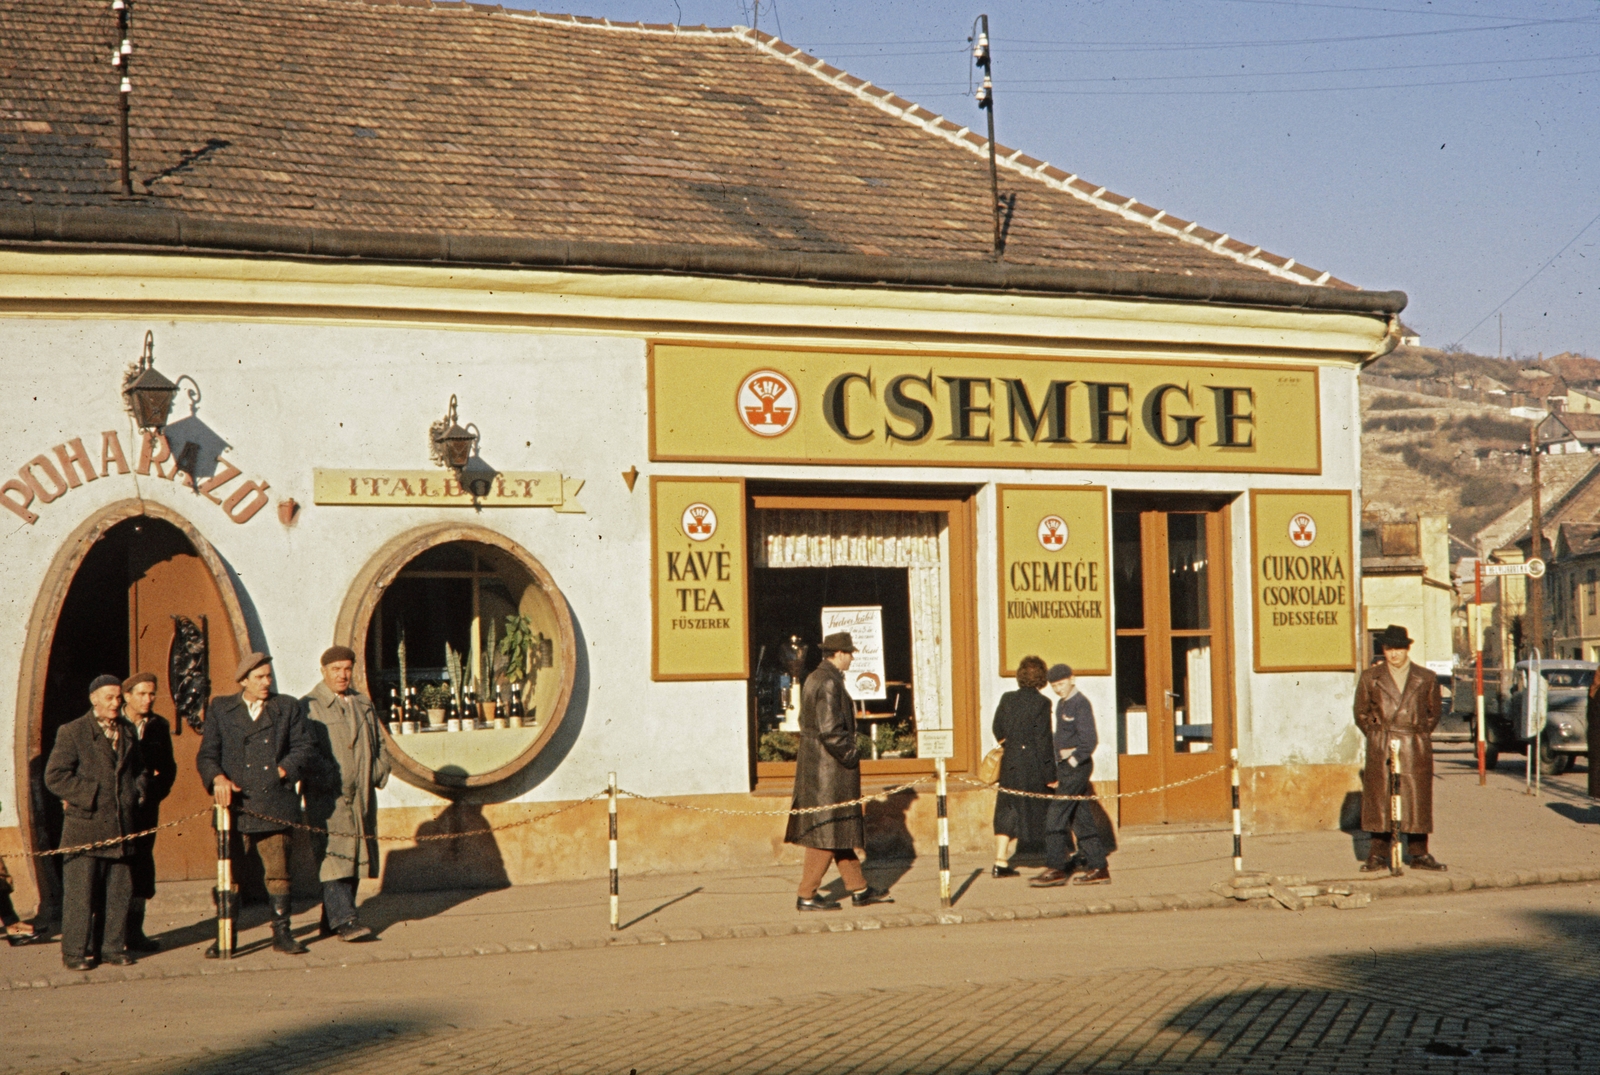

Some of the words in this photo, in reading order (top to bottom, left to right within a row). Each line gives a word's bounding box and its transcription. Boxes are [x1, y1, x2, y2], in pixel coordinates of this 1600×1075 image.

[764, 412, 773, 424] 1
[822, 365, 1257, 450] CSEMEGE
[349, 476, 541, 498] ITALBOLT
[666, 543, 731, 581] KÁVÉ
[1262, 554, 1345, 581] CUKORKA
[1010, 561, 1098, 592] CSEMEGE
[676, 588, 725, 612] TEA
[1263, 581, 1346, 606] CSOKOLÁDÉ
[1007, 596, 1102, 619] KÜLÖNLEGESSÉGEK
[1272, 607, 1338, 626] ÉDESSÉGEK
